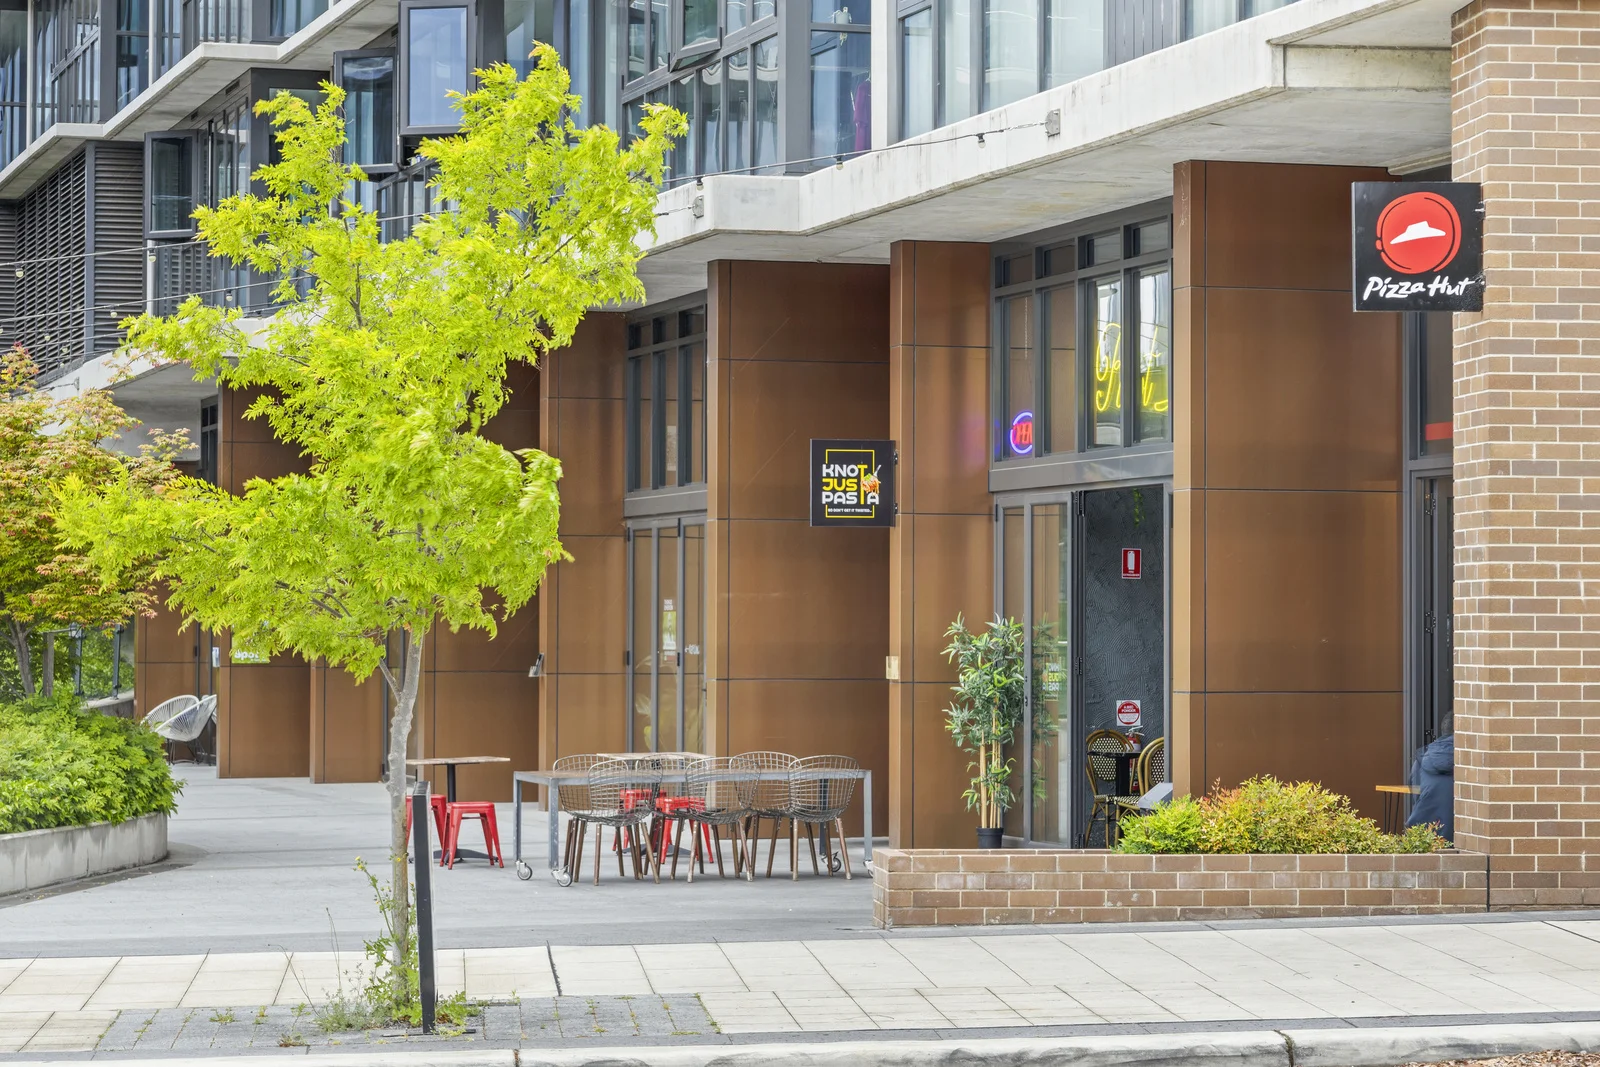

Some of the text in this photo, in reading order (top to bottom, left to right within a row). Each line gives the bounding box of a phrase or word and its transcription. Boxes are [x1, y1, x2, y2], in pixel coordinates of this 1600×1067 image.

[1363, 275, 1476, 301] Pizza Hut
[822, 464, 868, 478] KNOT
[821, 492, 880, 505] PASTA
